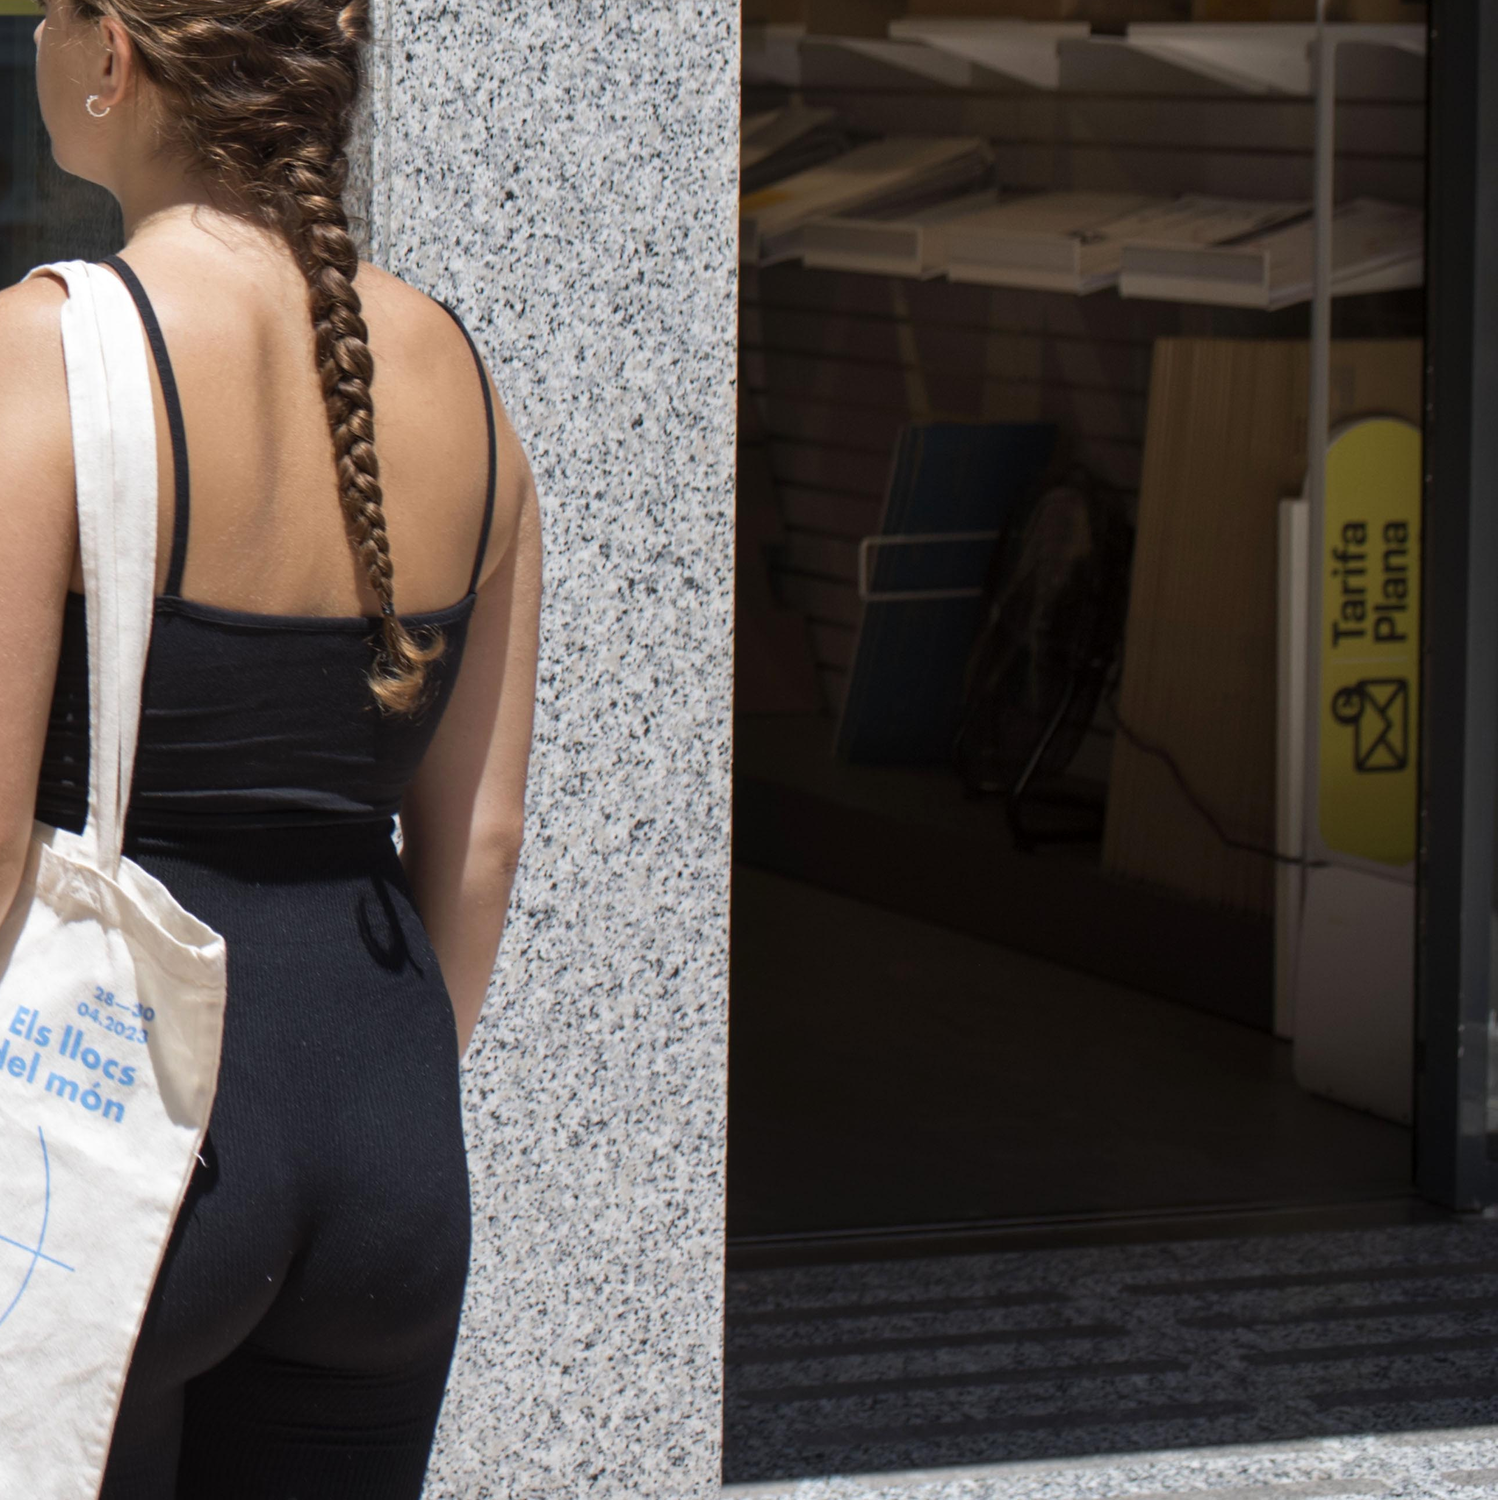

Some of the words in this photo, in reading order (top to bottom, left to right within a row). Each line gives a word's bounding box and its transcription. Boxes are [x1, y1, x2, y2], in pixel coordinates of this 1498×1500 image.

[1332, 520, 1369, 648] Tarifa
[1372, 520, 1410, 644] Plana
[9, 1004, 52, 1047] Els
[58, 1024, 137, 1087] llocs
[77, 1001, 149, 1045] 04.2023
[45, 1071, 126, 1123] món
